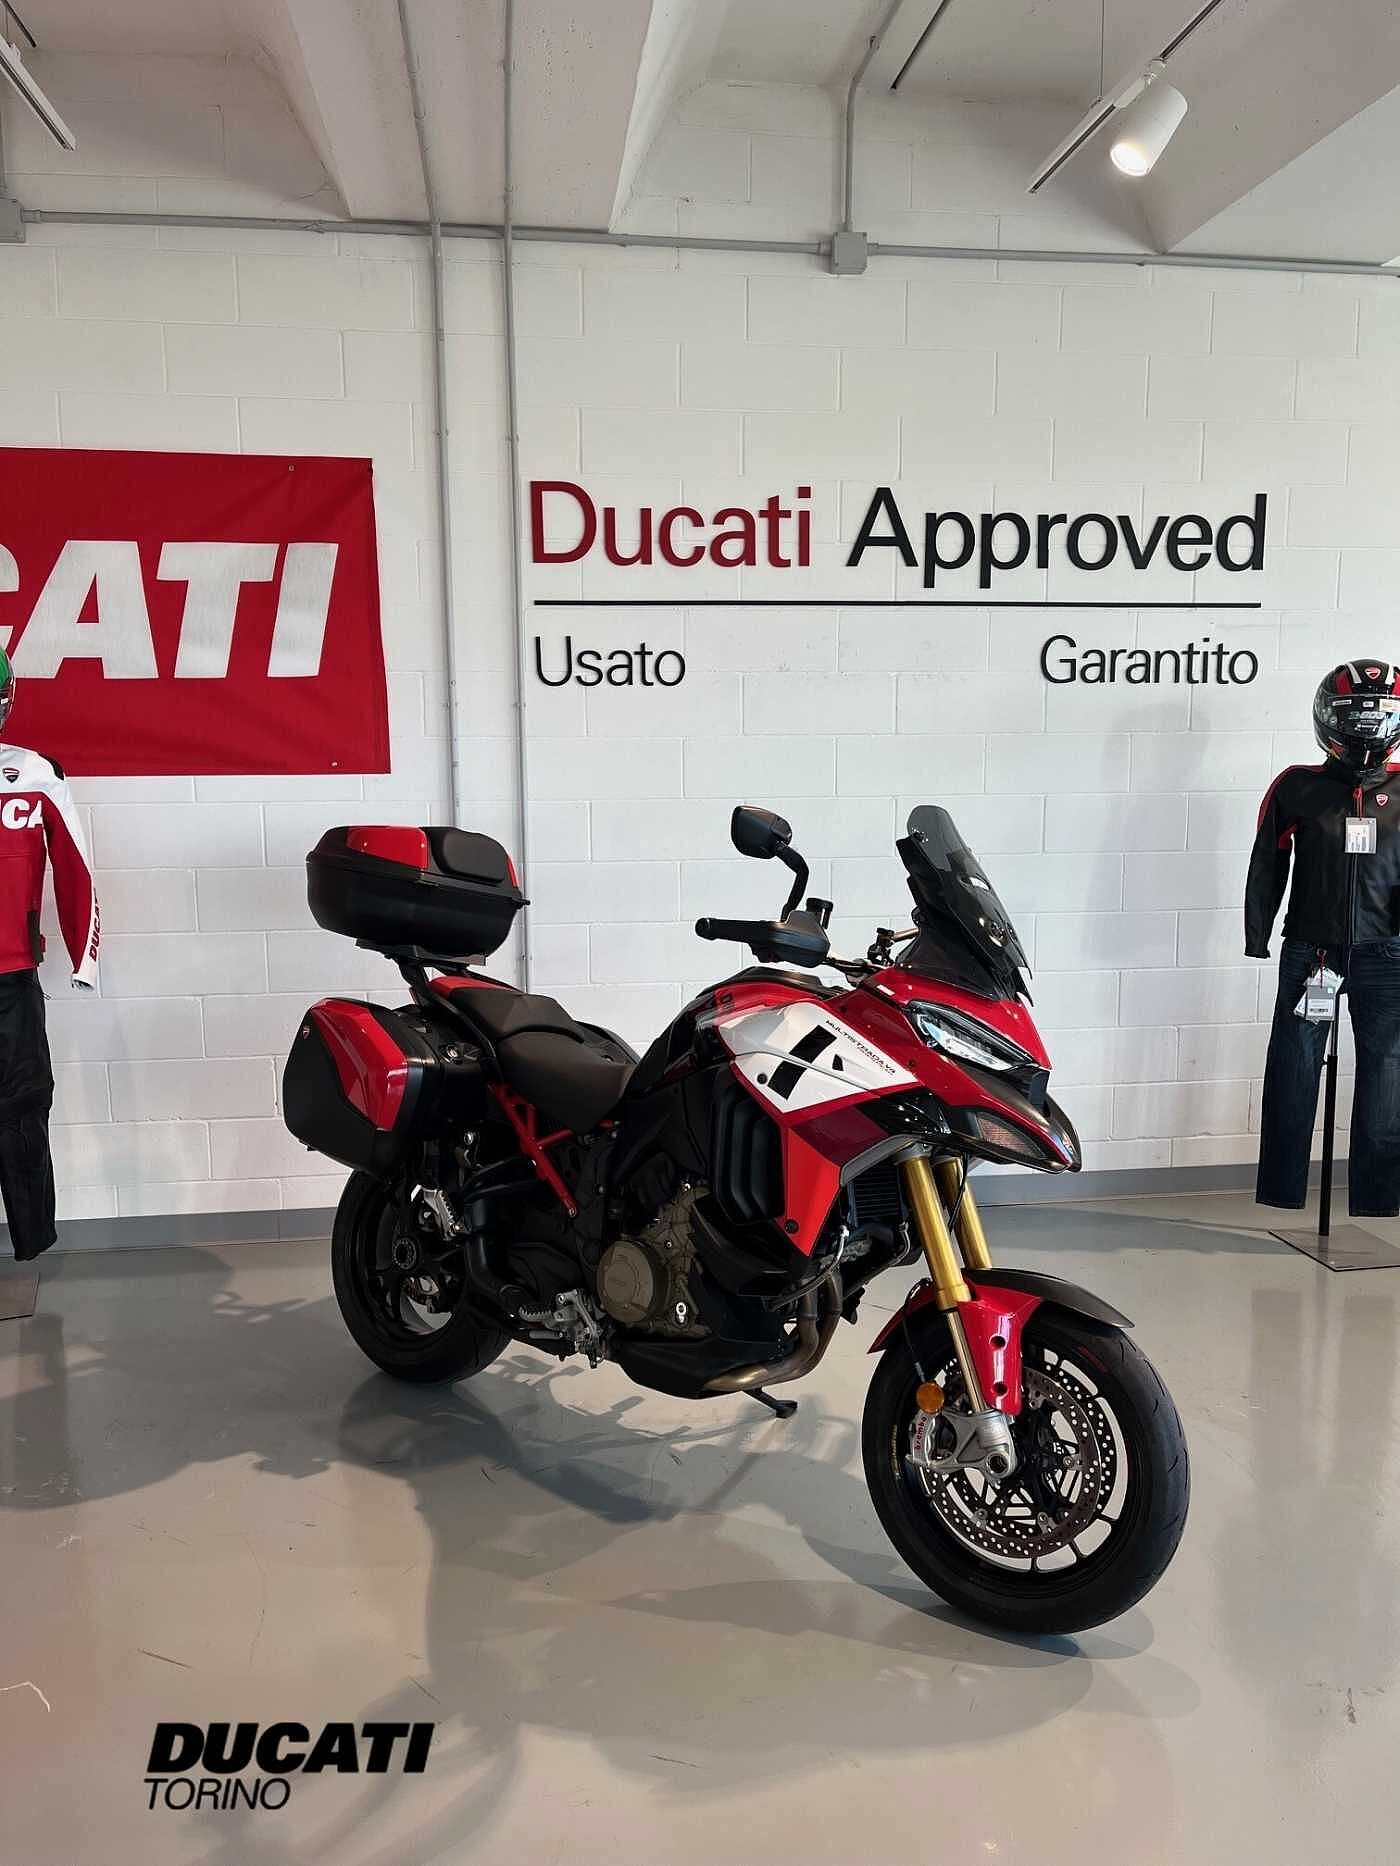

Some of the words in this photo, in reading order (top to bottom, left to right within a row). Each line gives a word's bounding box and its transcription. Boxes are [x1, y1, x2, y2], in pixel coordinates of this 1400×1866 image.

[529, 480, 812, 568] Ducati
[846, 486, 1267, 589] Approved
[0, 540, 339, 680] ATI
[535, 636, 686, 687] Usato
[1040, 635, 1258, 685] Garantito
[825, 1020, 885, 1065] MULTISTRADA
[914, 1416, 928, 1450] brembo
